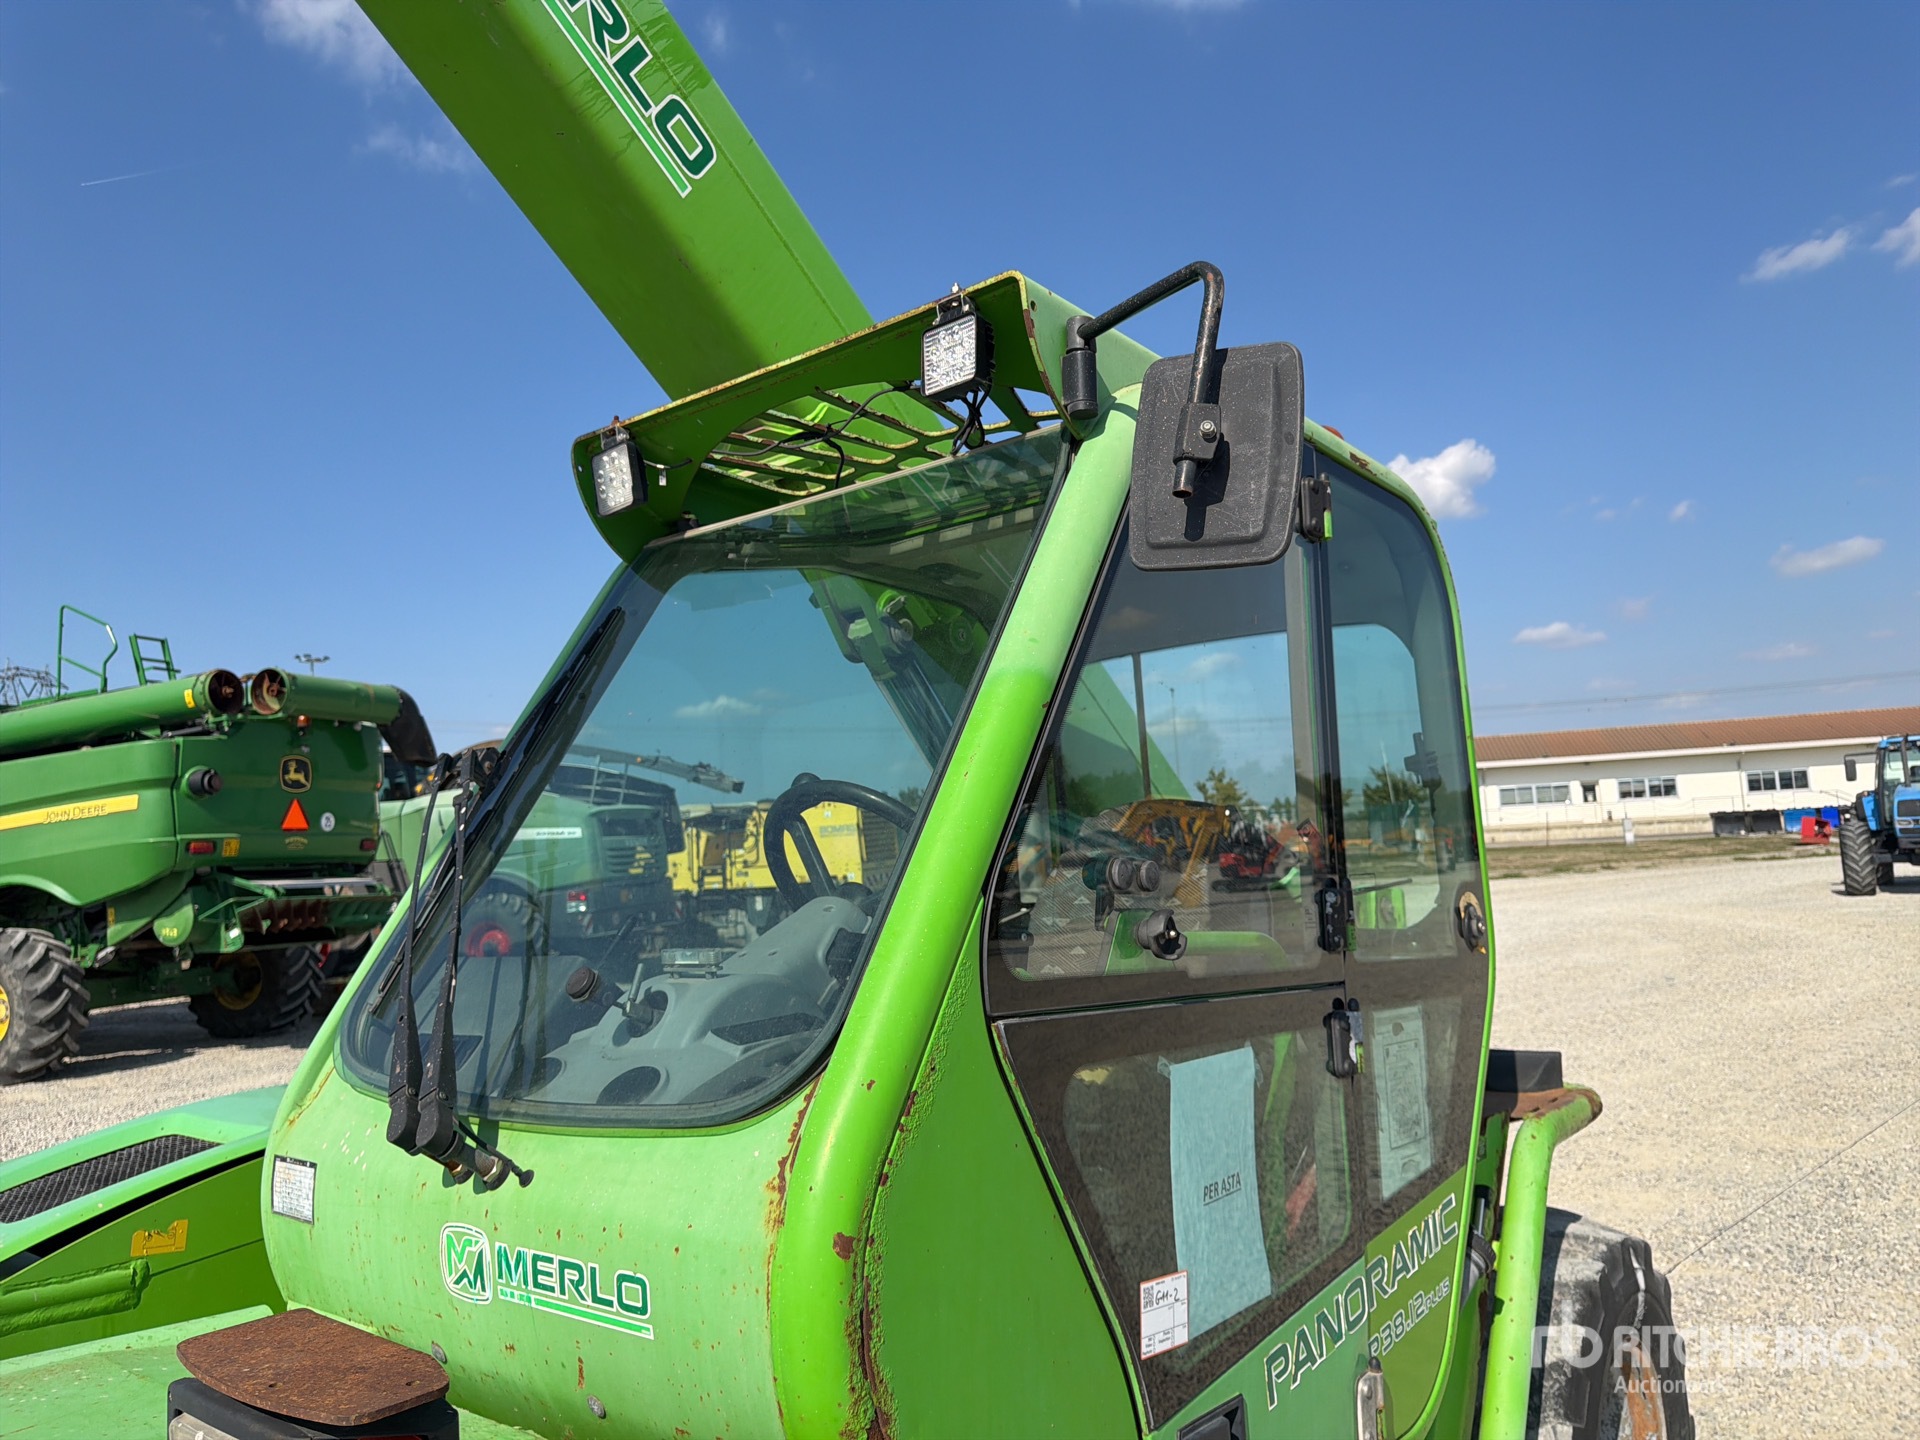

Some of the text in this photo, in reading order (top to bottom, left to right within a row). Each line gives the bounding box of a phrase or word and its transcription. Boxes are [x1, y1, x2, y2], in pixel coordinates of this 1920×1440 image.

[563, 0, 717, 180] RLO
[43, 803, 108, 824] JOHN DEERE
[1203, 1171, 1241, 1202] PER ASTA
[495, 1241, 650, 1319] MERLO
[1264, 1193, 1458, 1411] PANORAMIC
